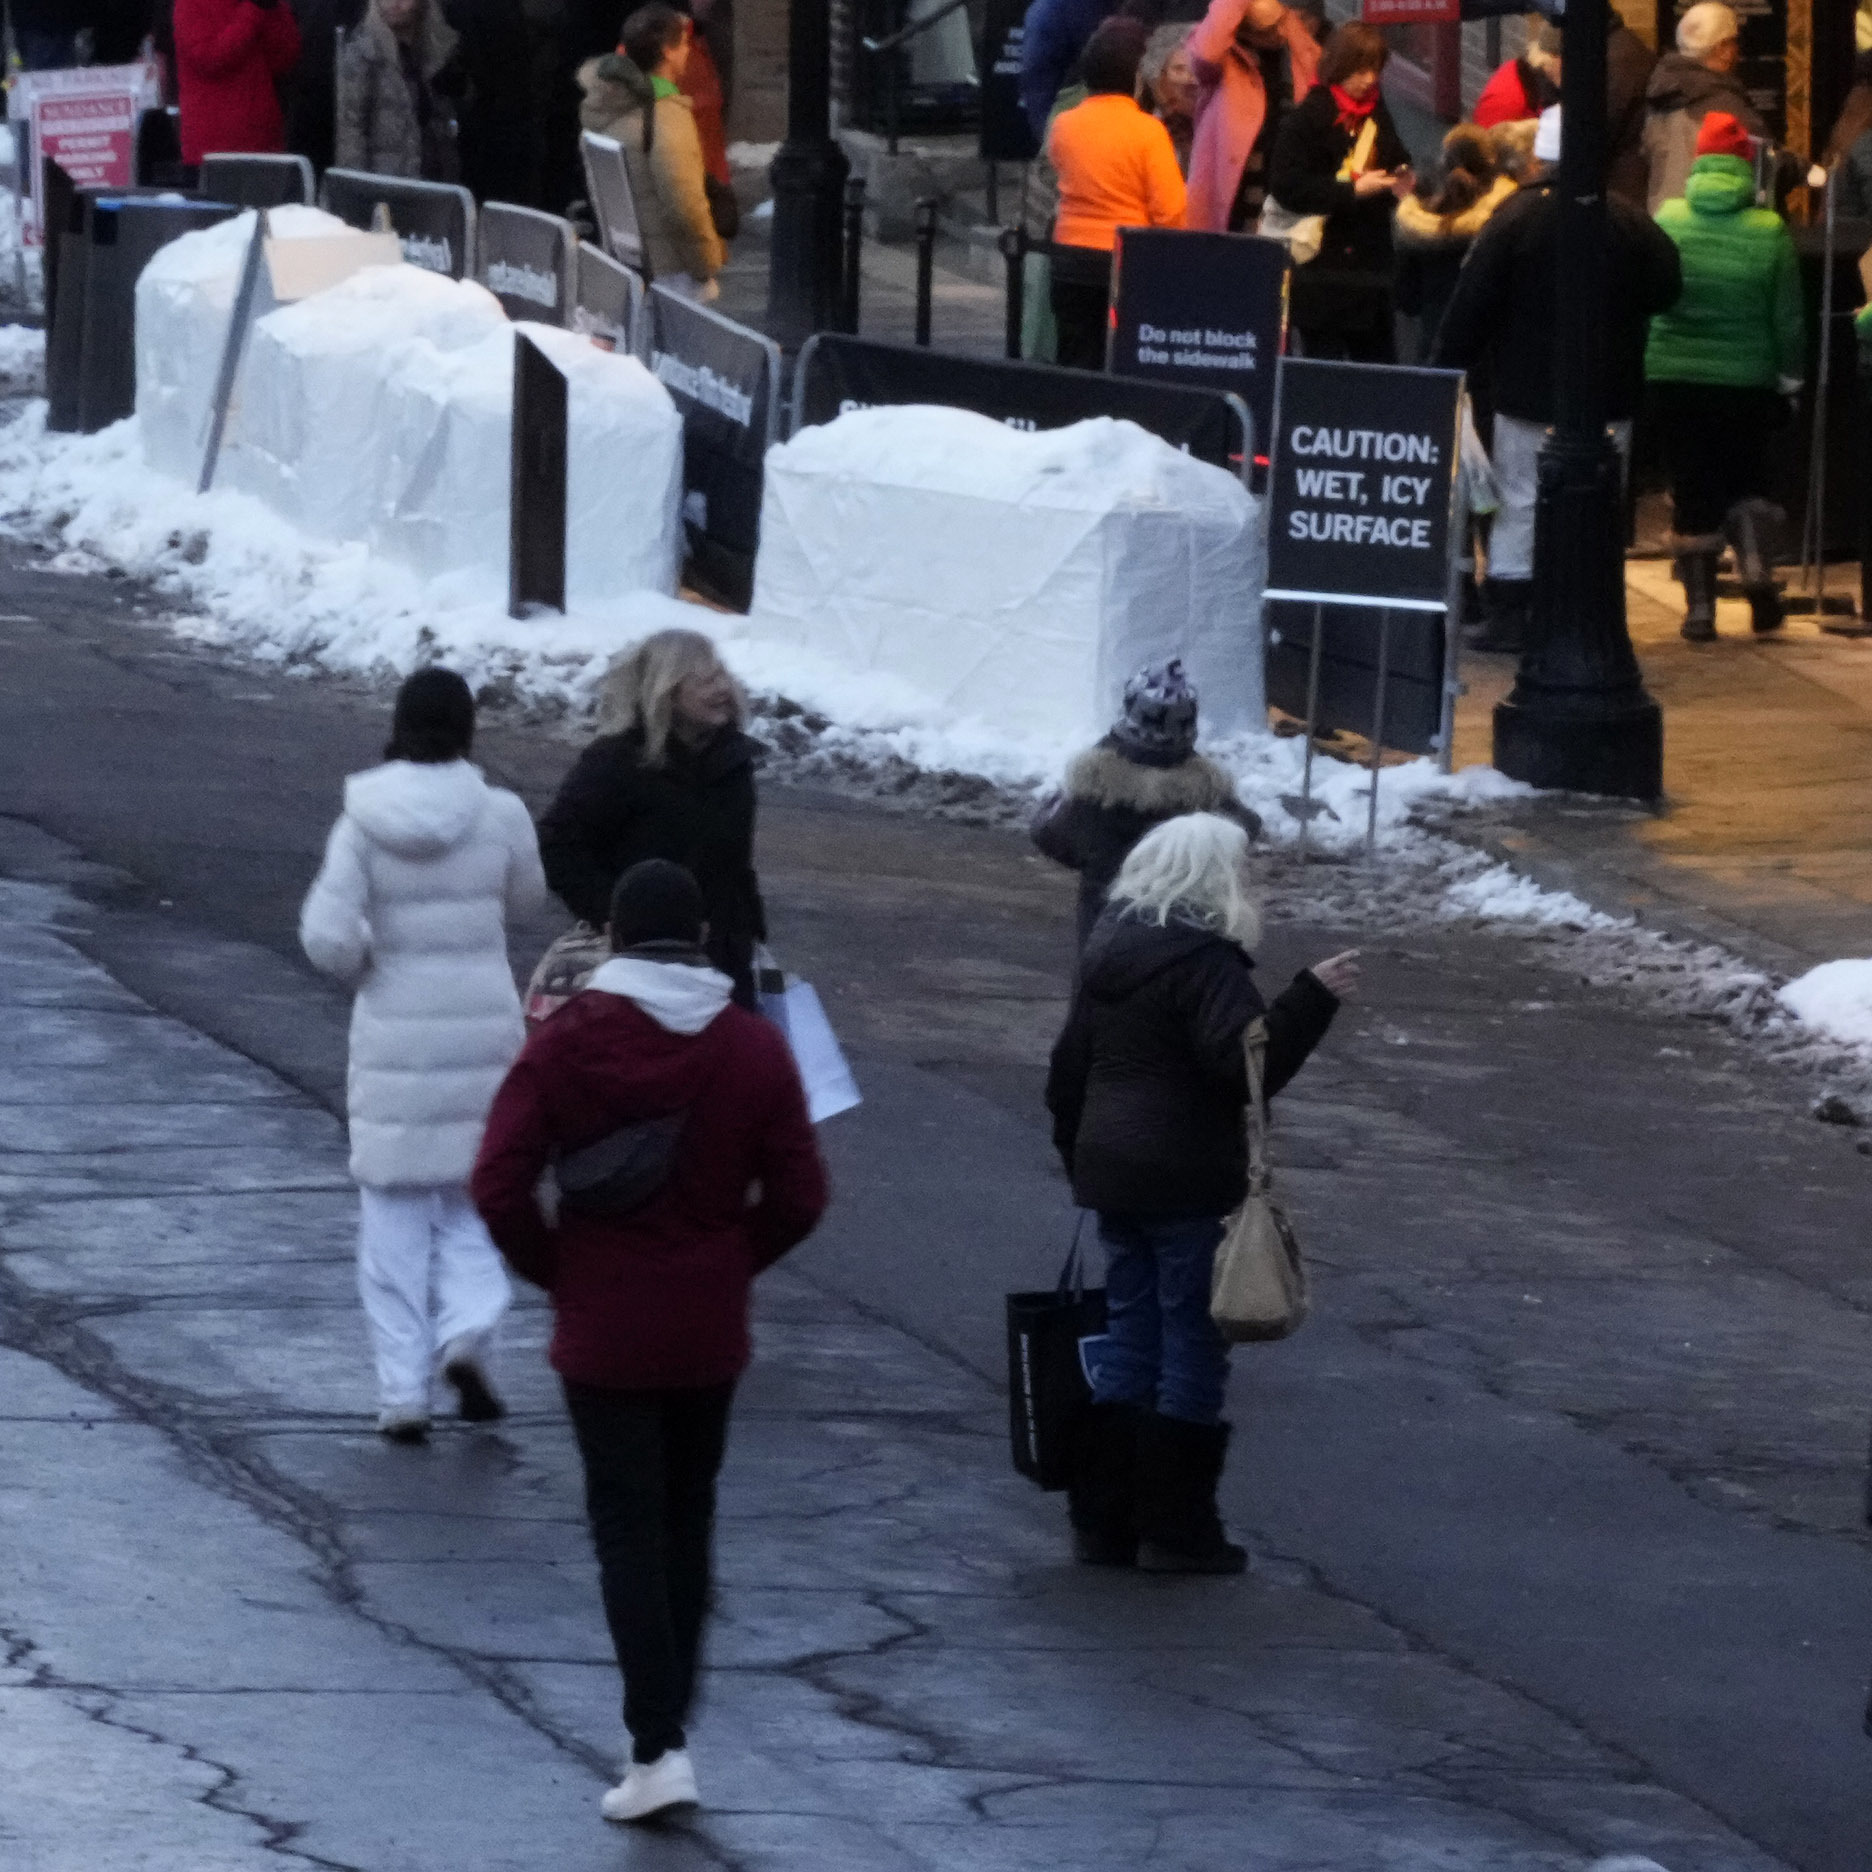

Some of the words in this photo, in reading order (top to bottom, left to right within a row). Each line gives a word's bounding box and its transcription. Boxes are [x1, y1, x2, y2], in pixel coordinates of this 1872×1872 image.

[1139, 324, 1166, 344] Do
[1169, 328, 1202, 346] not
[1205, 328, 1257, 350] block
[1138, 346, 1169, 365] the
[1173, 348, 1256, 370] sidewalk
[1290, 425, 1440, 464] CAUTION:
[1295, 469, 1367, 505] WET,
[1382, 475, 1431, 506] ICY
[1288, 510, 1431, 549] SURFACE
